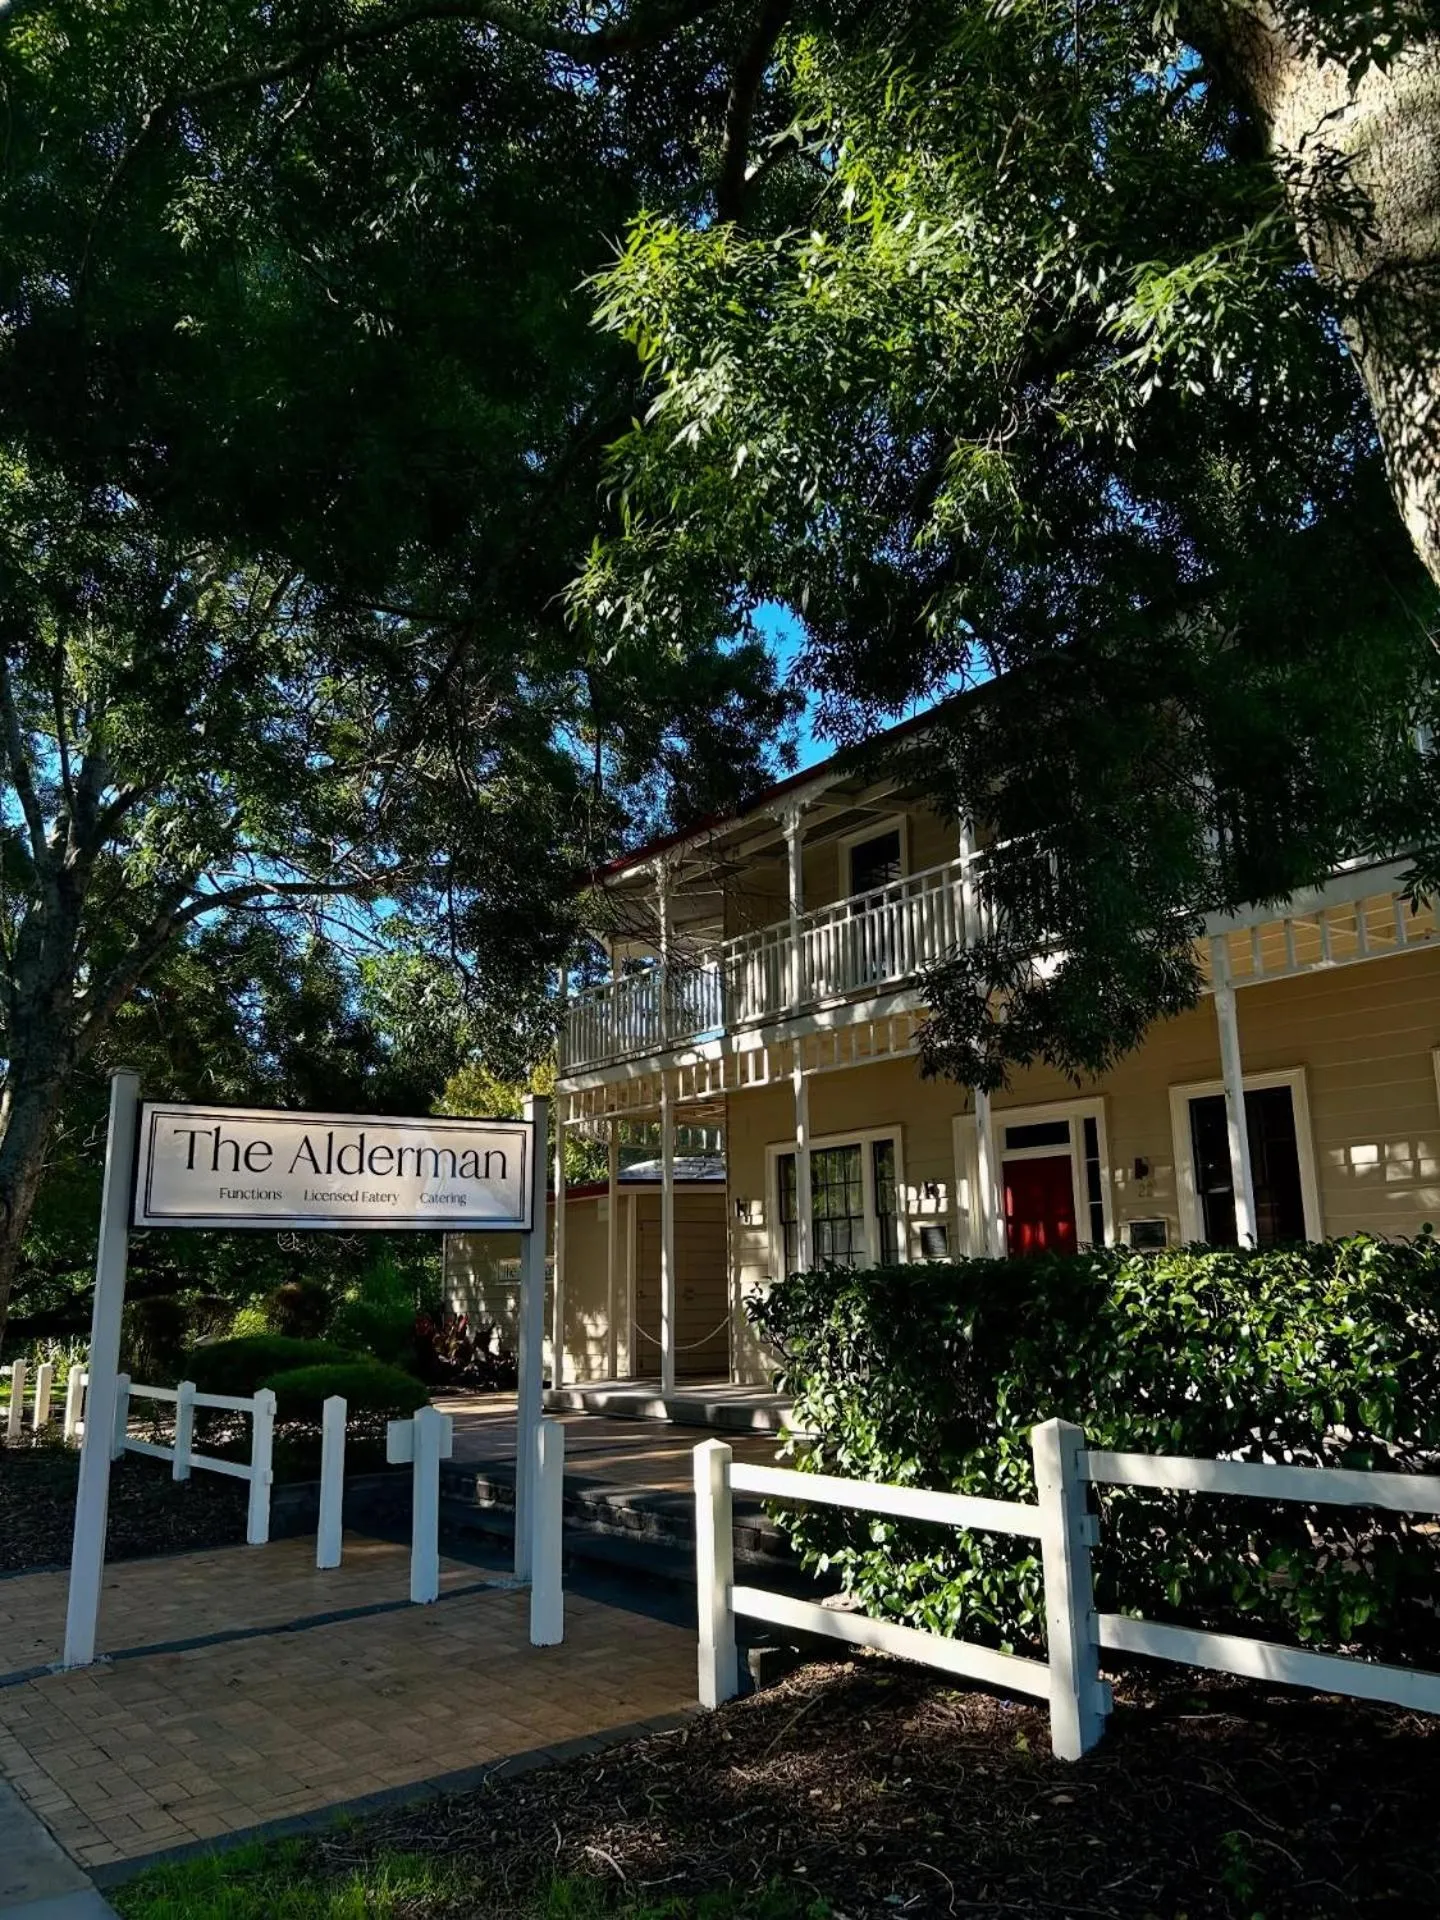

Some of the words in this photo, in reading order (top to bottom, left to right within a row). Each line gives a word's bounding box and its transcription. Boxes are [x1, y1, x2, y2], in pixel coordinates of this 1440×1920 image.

[173, 1126, 272, 1172] The
[288, 1132, 507, 1180] Alderman
[219, 1187, 282, 1200] Functions
[303, 1188, 359, 1203] Licensed
[361, 1190, 399, 1206] Eatery
[419, 1191, 468, 1205] Catering
